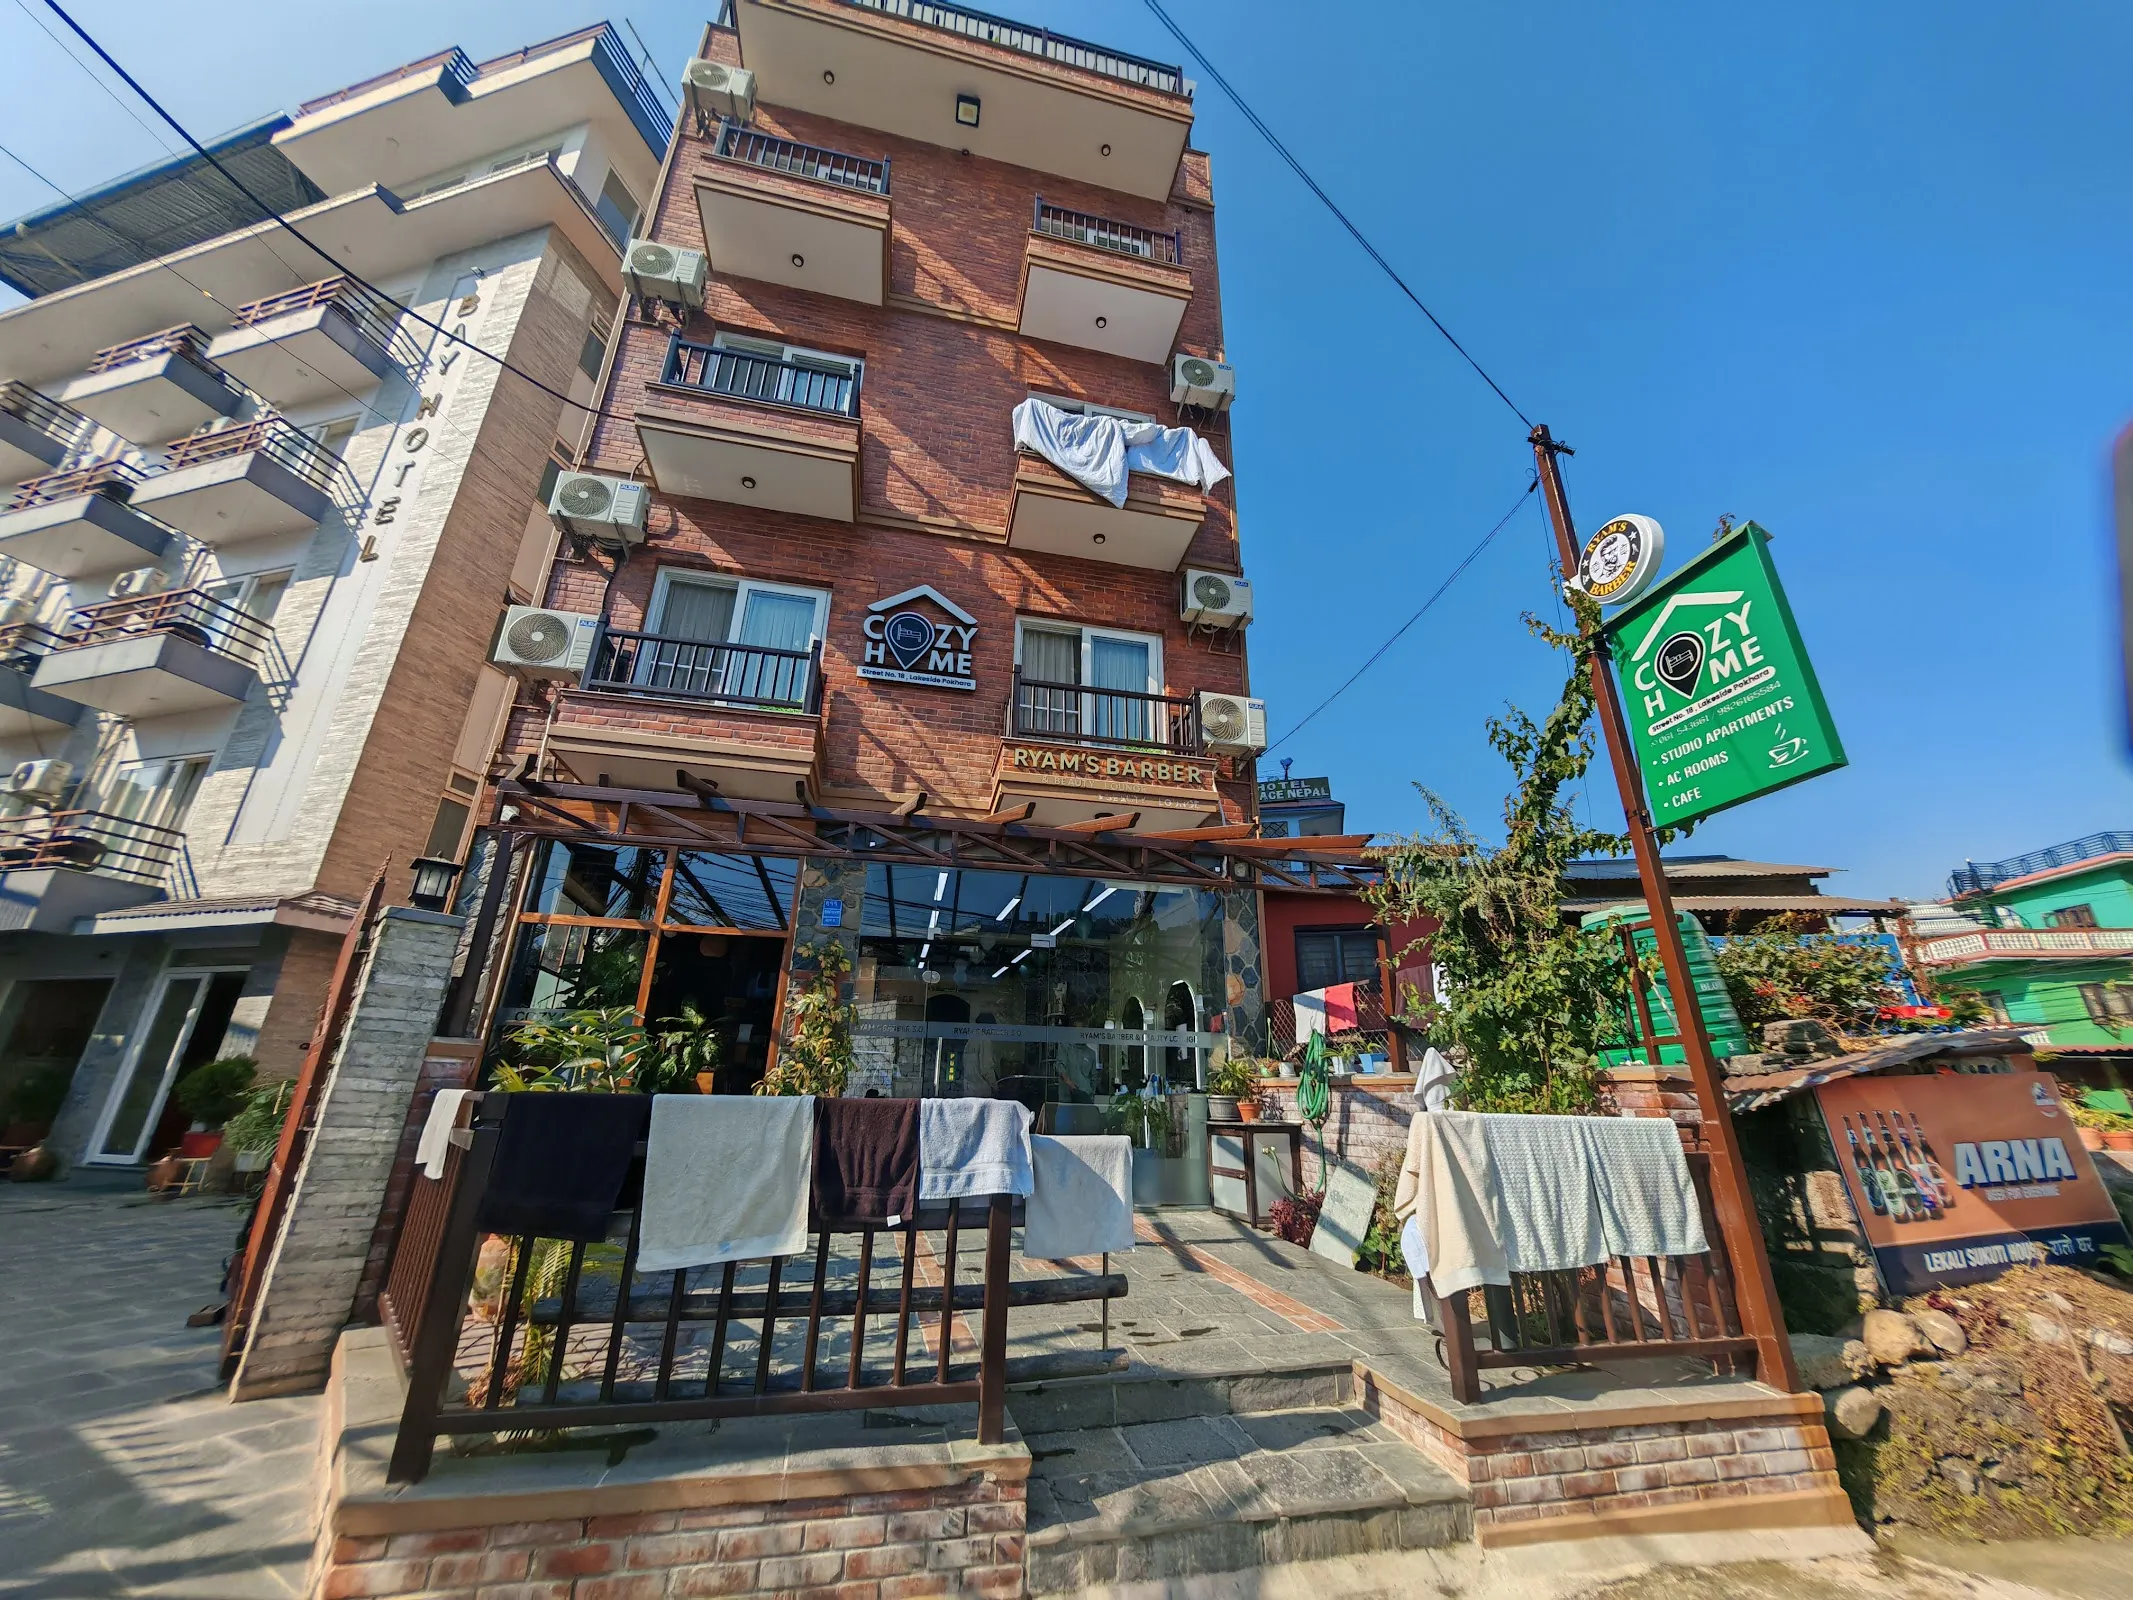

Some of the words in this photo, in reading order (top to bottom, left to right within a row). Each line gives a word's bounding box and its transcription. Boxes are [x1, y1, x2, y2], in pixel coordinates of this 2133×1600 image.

[440, 294, 481, 376] BAY
[359, 392, 443, 563] HOTEL
[1586, 521, 1628, 554] RYAM'S
[1589, 560, 1637, 596] BARBER
[862, 668, 884, 677] Street
[909, 674, 941, 684] Lakeside
[942, 678, 972, 687] Pokhara
[1651, 717, 1673, 733] Street
[1673, 713, 1686, 722] No.
[1686, 706, 1694, 715] 18
[1697, 687, 1733, 709] Lakeside
[1733, 668, 1771, 690] Pokhara
[1660, 737, 1703, 765] STUDIO
[1705, 695, 1796, 745] APARTMENTS
[1013, 747, 1100, 775] RYAM'S
[1106, 757, 1203, 784] BARBER
[1666, 770, 1682, 786] AC
[1683, 750, 1730, 779] ROOMS
[1041, 775, 1049, 784] &
[1054, 776, 1096, 789] BEAUTY
[1104, 782, 1147, 793] LOUNGE
[1258, 779, 1311, 792] HOTEL
[1259, 790, 1284, 801] ACE
[1286, 786, 1330, 799] NEPAL
[1672, 786, 1703, 808] CAFE
[1080, 1031, 1106, 1040] RYAM'S
[1953, 1136, 2078, 1189] ARNA
[1922, 1249, 1968, 1273] LEKALI
[1965, 1243, 2010, 1268] SUKUTI
[2005, 1240, 2038, 1263] HOUS
